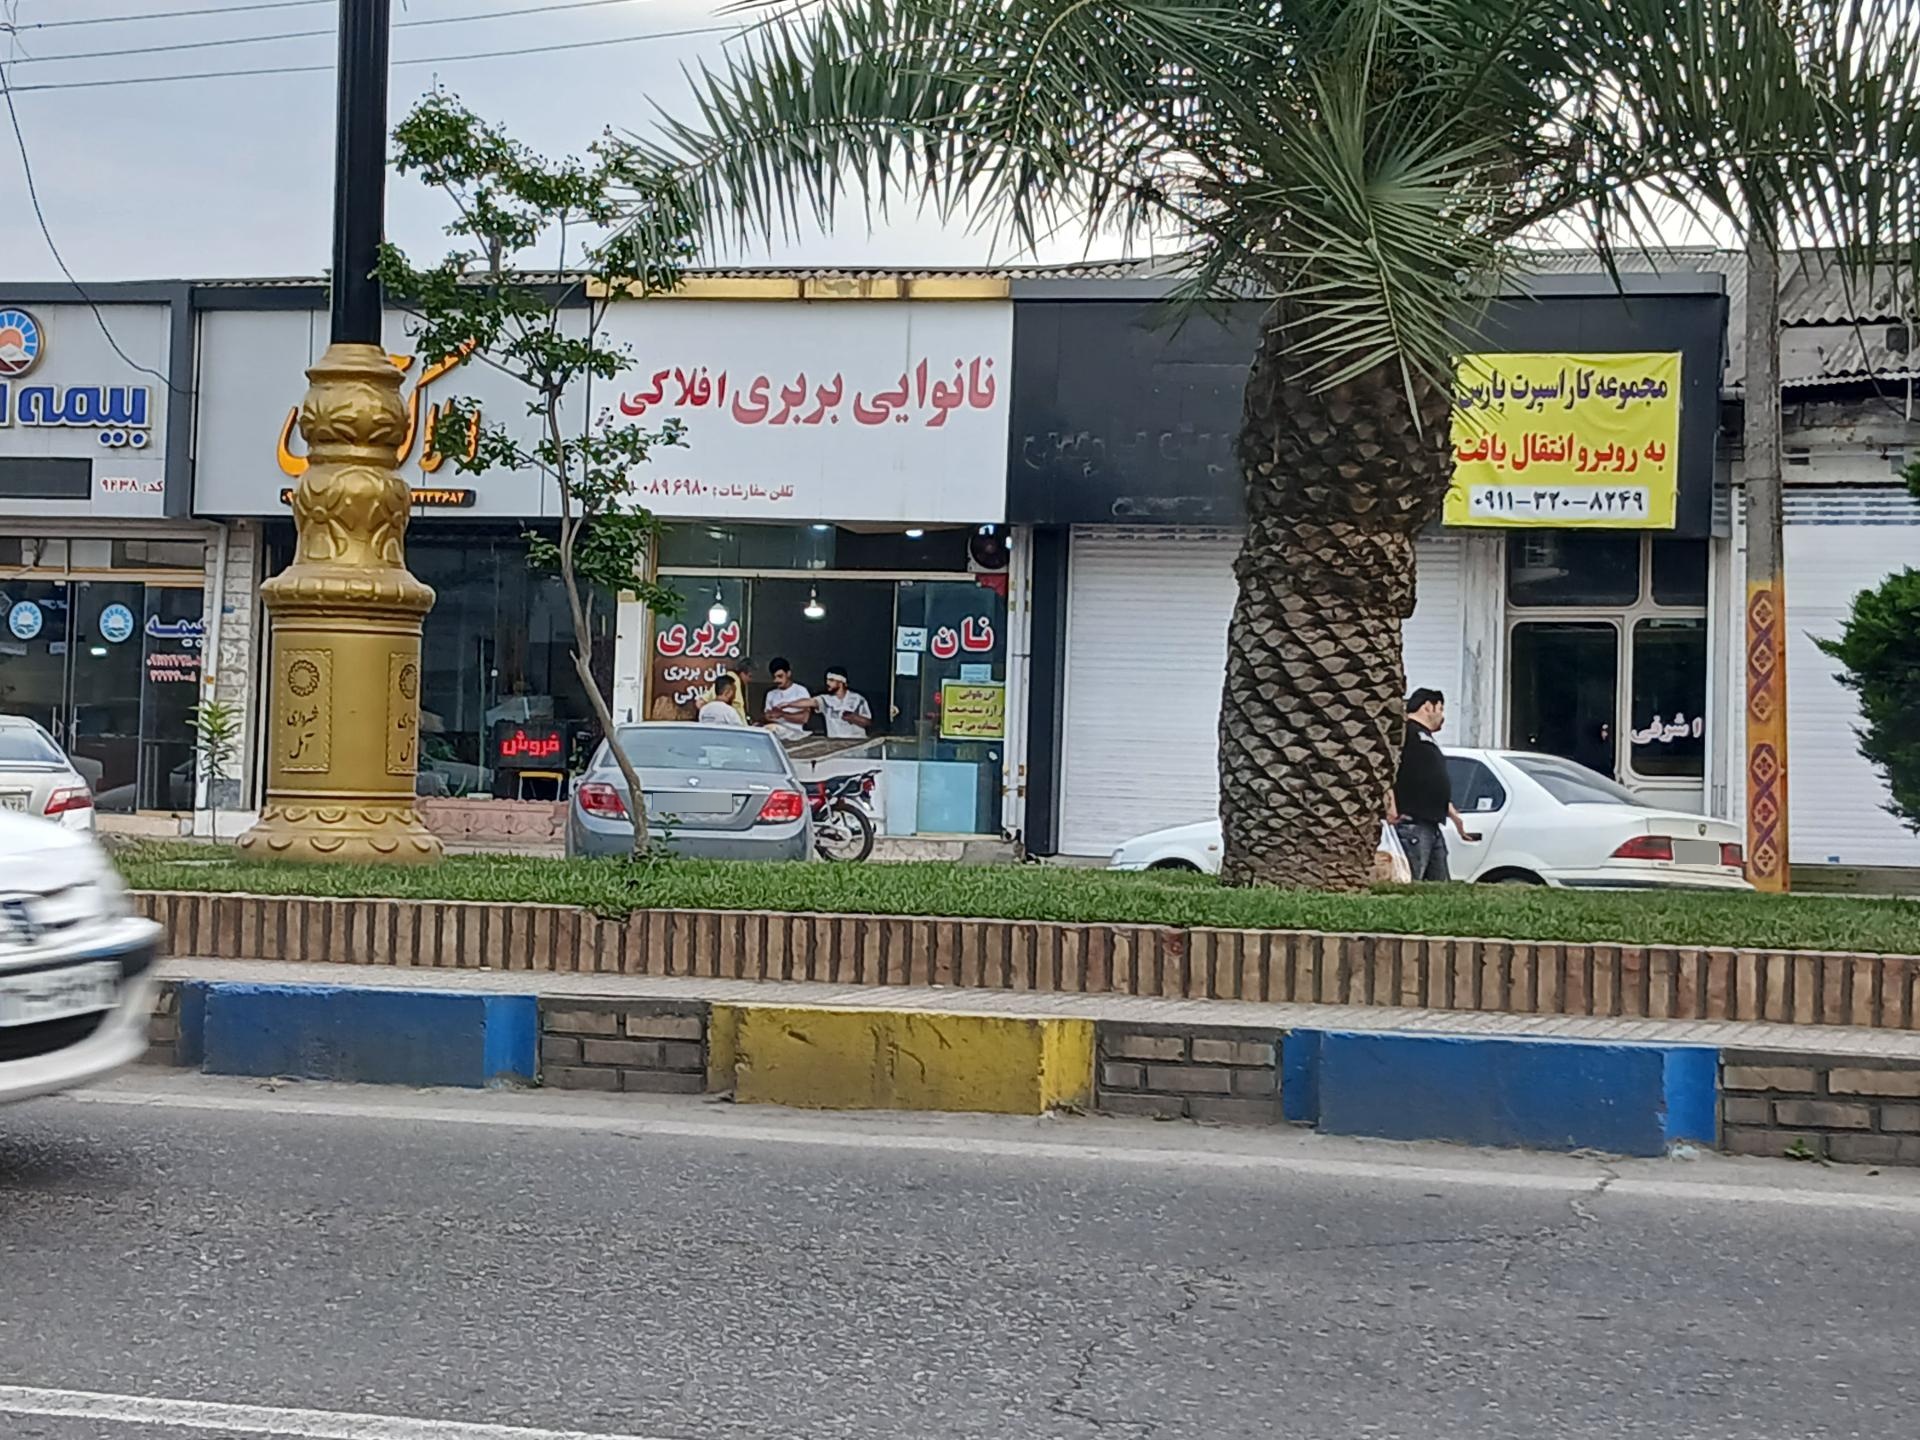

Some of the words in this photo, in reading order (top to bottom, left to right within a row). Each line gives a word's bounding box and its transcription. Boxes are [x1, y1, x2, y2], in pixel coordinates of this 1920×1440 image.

[619, 366, 727, 416] افلاکی
[731, 372, 844, 425] بربری
[852, 356, 996, 427] نانوایی
[1595, 376, 1669, 410] مجموعه
[18, 385, 150, 448] بیمه
[1455, 430, 1507, 469] یافت
[1511, 432, 1575, 472] انتقال
[1574, 441, 1640, 473] روبرو
[1643, 440, 1667, 472] به
[657, 620, 740, 658] بربری
[931, 616, 994, 658] نان
[663, 666, 700, 681] بربری
[703, 663, 727, 682] نان
[501, 730, 560, 757] فروش
[1630, 712, 1703, 745] اشرفی
